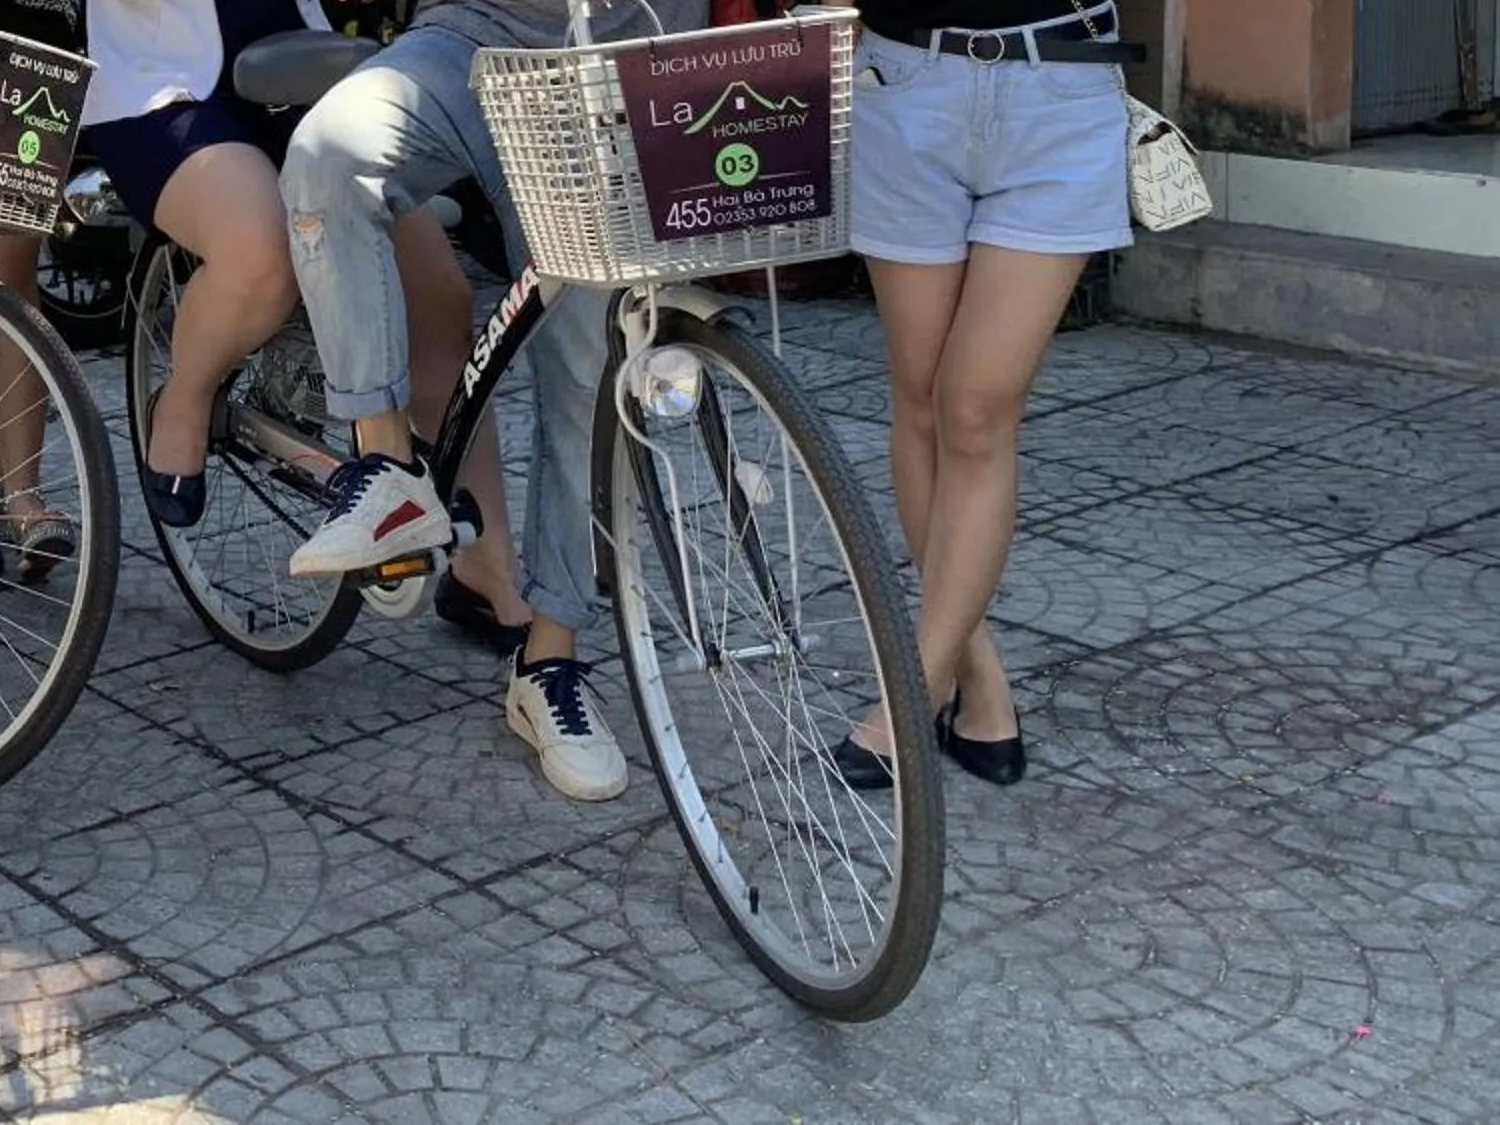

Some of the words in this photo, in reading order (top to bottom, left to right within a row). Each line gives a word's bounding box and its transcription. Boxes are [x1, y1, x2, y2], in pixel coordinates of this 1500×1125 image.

[701, 49, 728, 70] VỤ
[1, 79, 22, 106] La
[650, 99, 694, 127] La
[712, 111, 809, 139] HOMESTAY
[21, 139, 38, 154] 05
[721, 155, 755, 176] 03
[666, 197, 712, 230] 455
[712, 194, 740, 209] Hai
[463, 265, 541, 400] ASAMA
